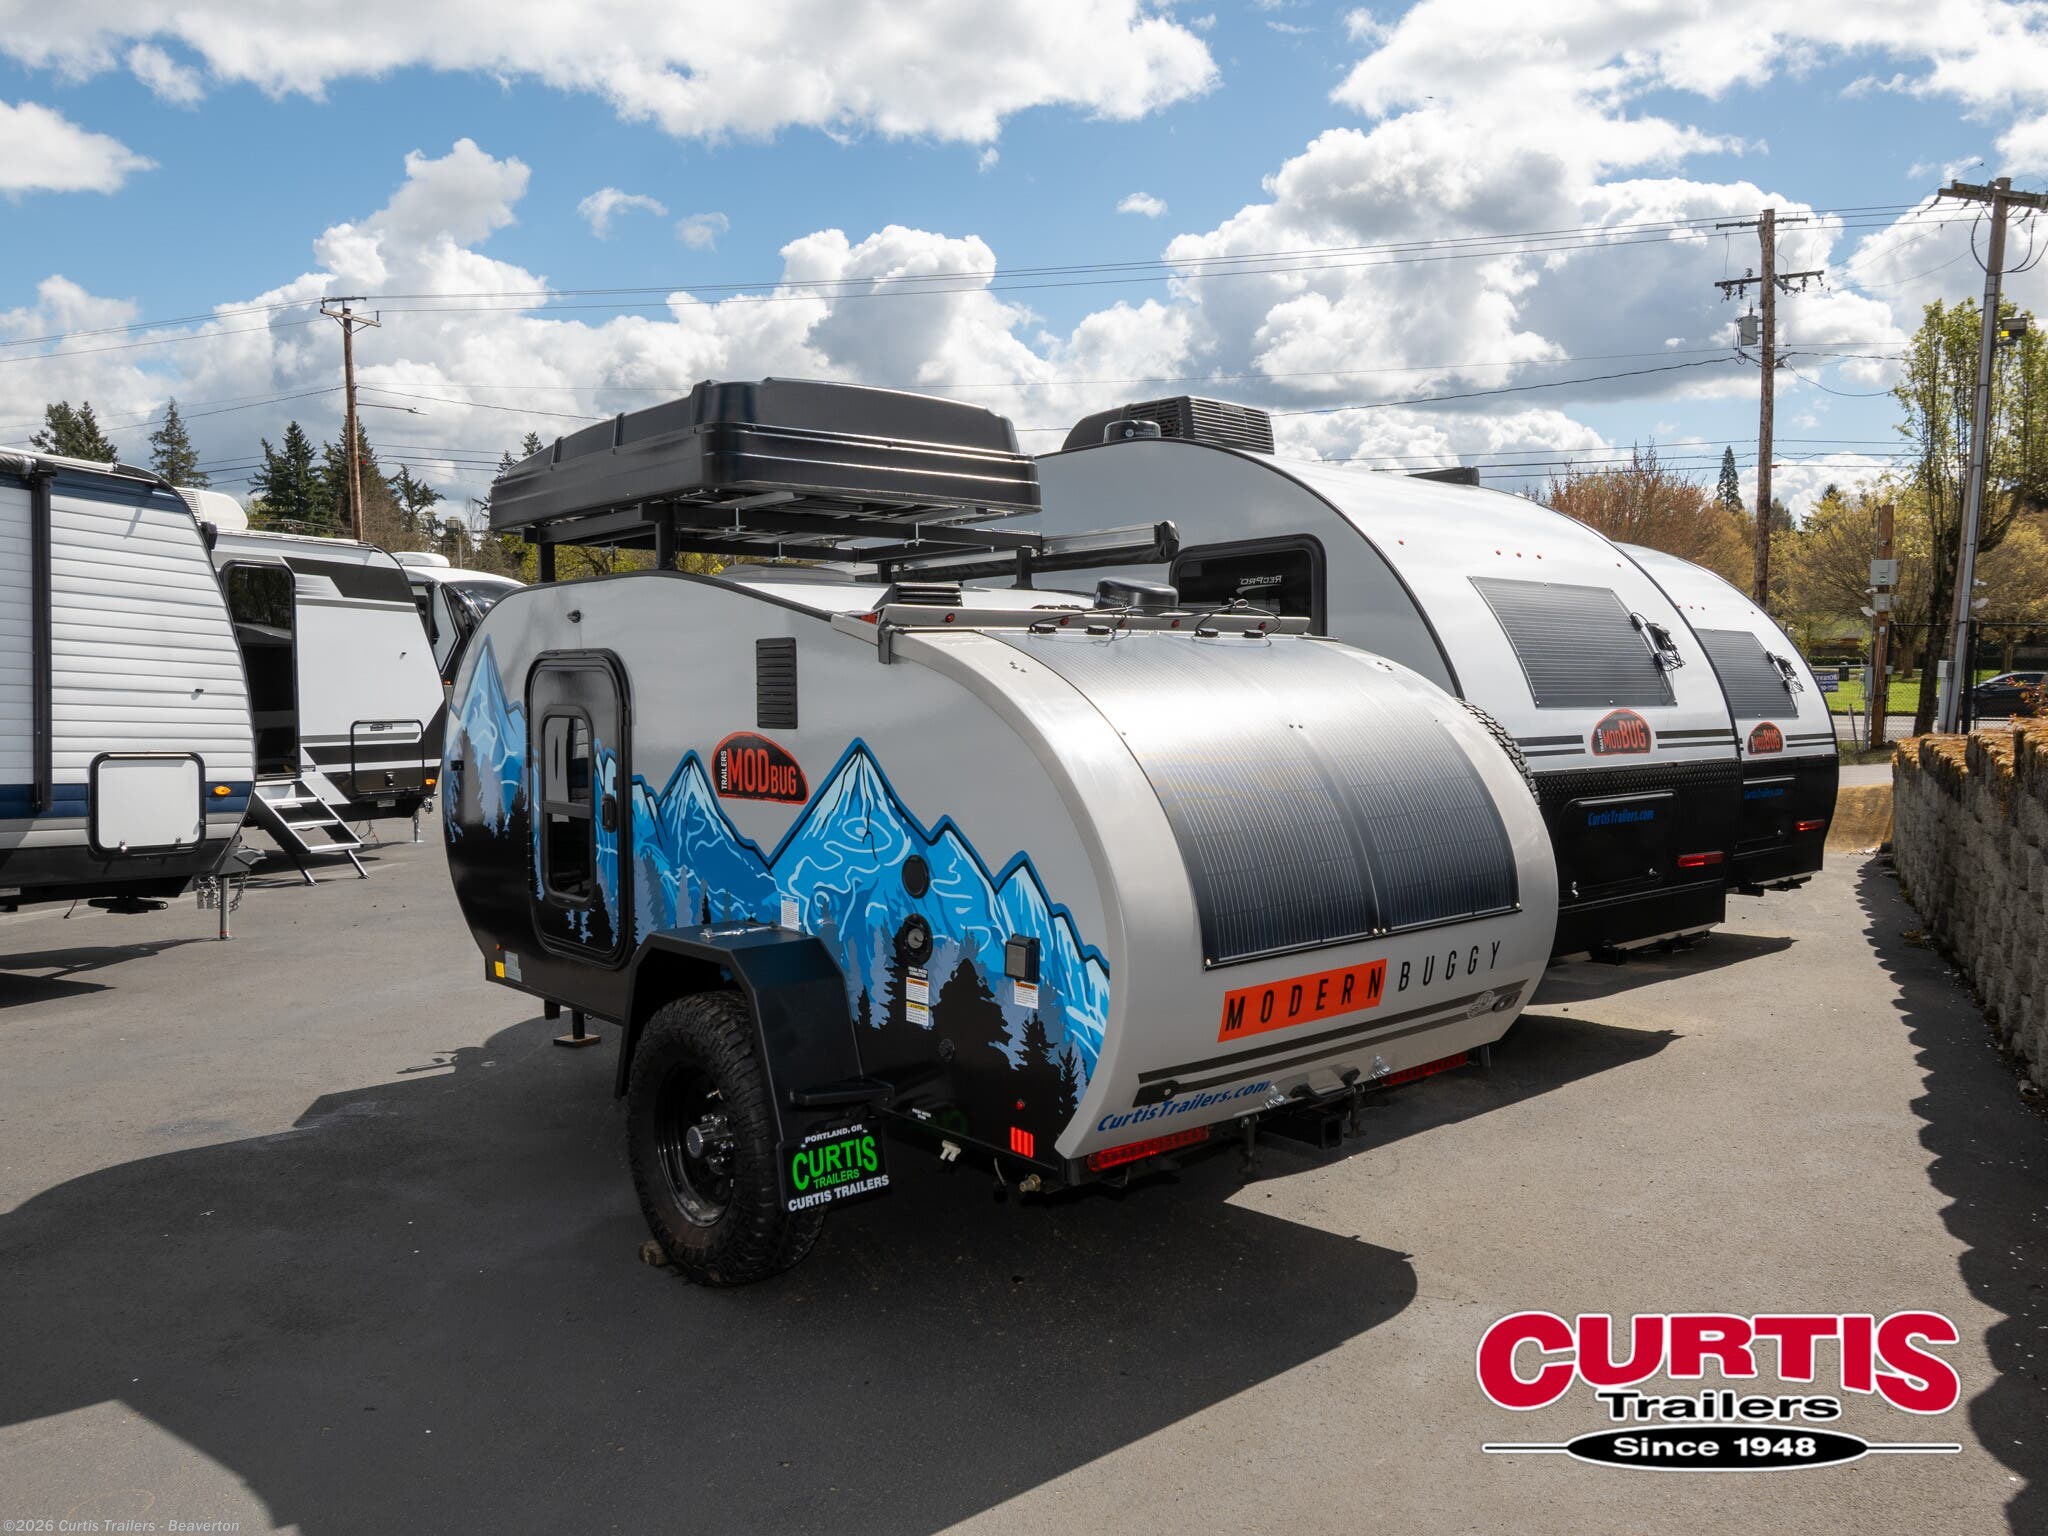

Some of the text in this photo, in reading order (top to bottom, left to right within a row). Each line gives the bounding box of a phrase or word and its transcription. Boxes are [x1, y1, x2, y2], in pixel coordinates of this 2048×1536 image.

[720, 750, 728, 790] TRAILERS
[1224, 940, 1501, 1032] MODERN BUGGY
[1097, 1080, 1272, 1132] CurtisTrailers.com
[804, 1124, 863, 1144] PORTLAND, OR
[792, 1136, 878, 1191] CURTIS
[813, 1168, 860, 1189] TRAILERS
[788, 1174, 890, 1212] CURTIS TRAILERS
